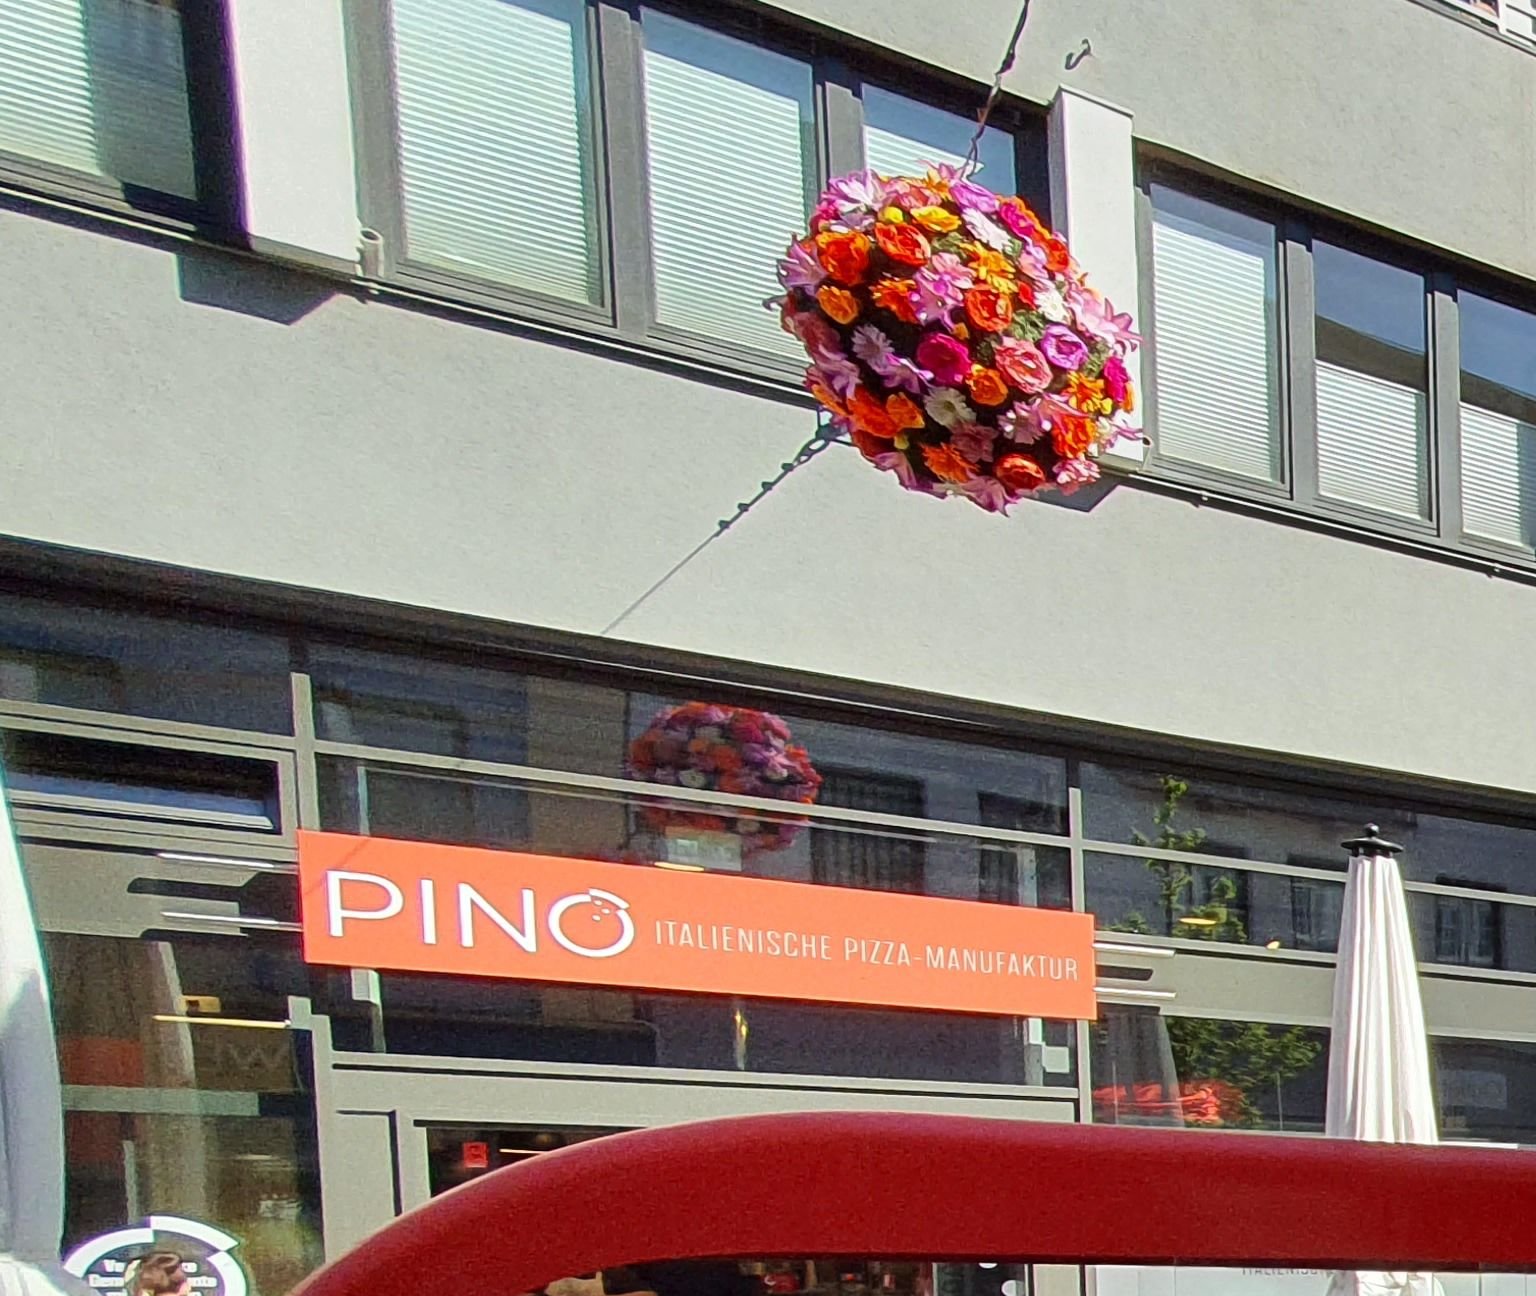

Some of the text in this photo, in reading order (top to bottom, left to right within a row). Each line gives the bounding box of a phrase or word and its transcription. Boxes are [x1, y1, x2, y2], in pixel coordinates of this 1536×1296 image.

[326, 869, 1080, 983] PINO ITALIENISCHE PIZZA-MANUFAKTUR
